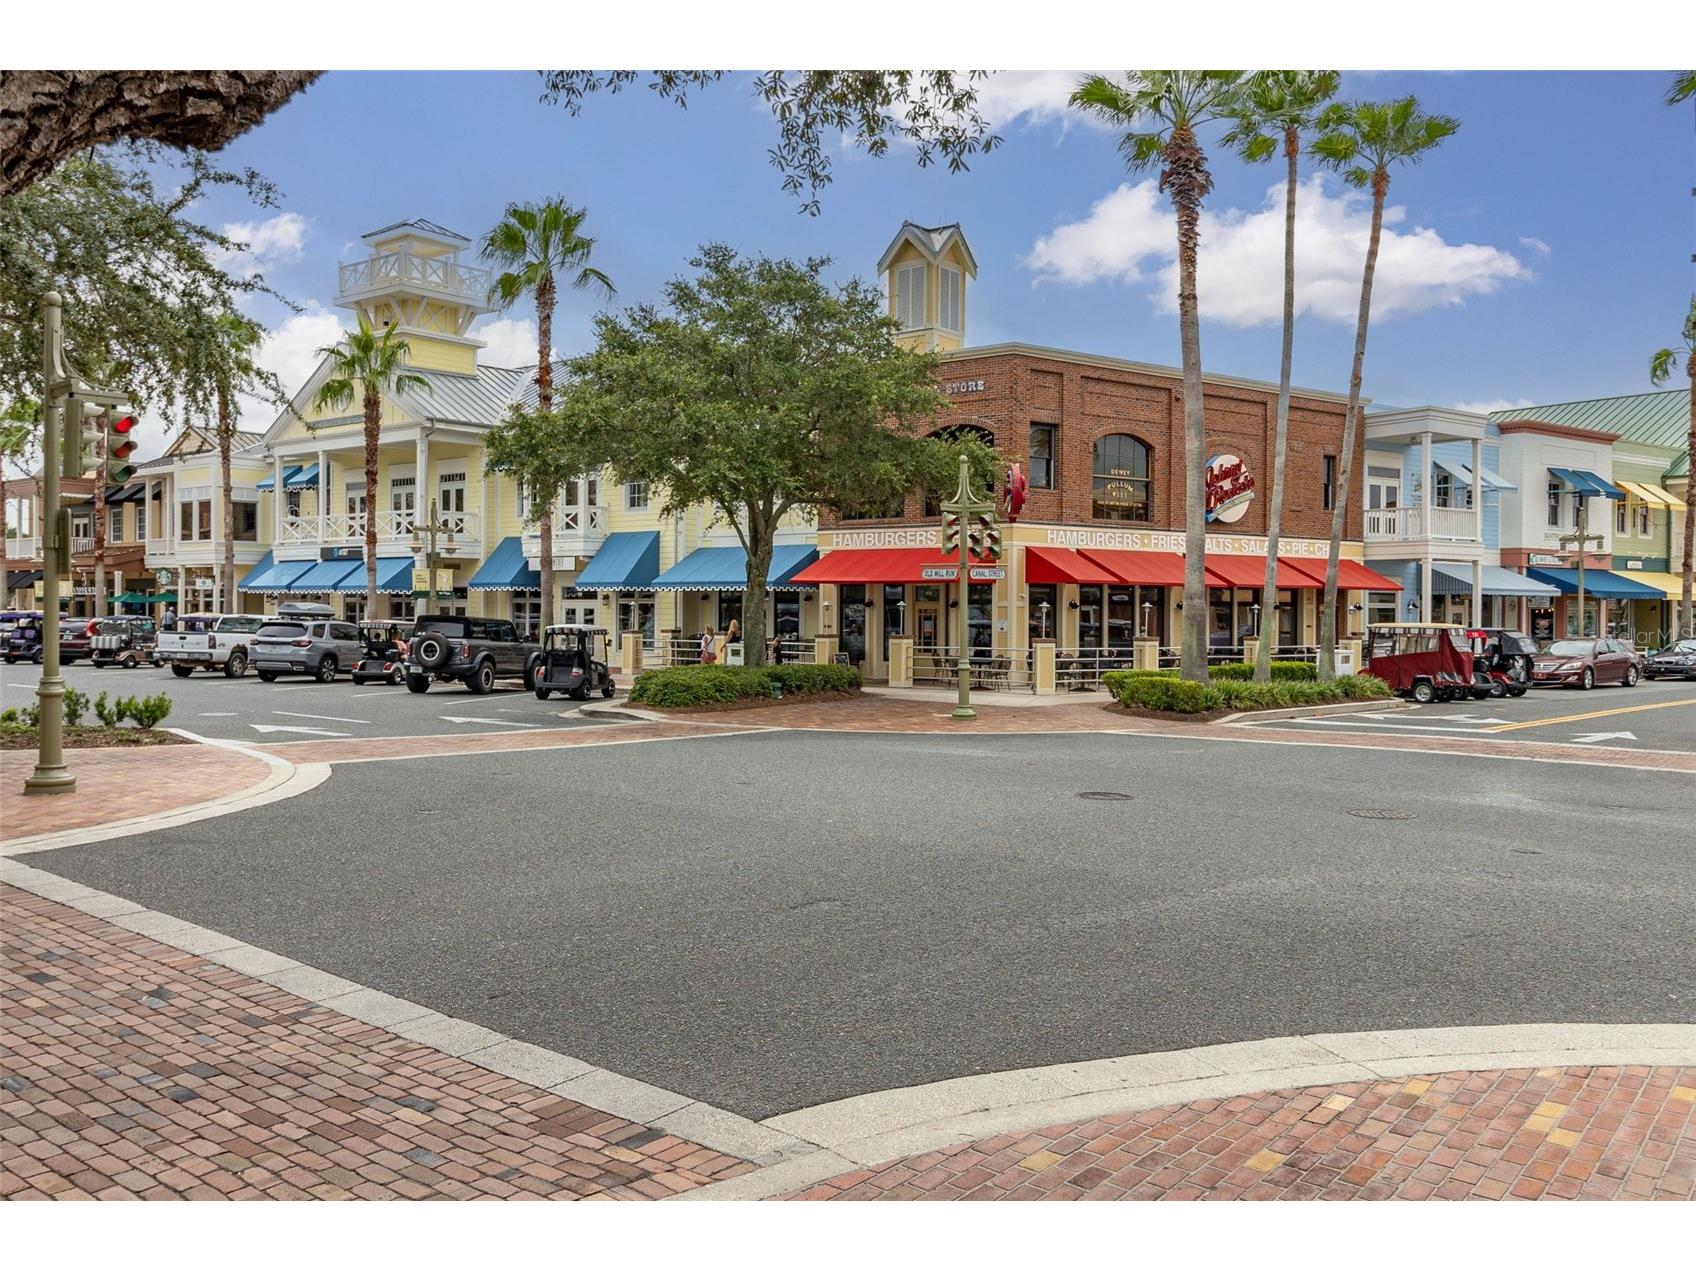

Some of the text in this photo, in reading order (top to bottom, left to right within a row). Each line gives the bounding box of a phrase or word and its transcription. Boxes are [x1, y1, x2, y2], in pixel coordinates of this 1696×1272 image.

[946, 380, 985, 394] STORE
[1106, 480, 1134, 493] PULLUM
[832, 530, 937, 547] HAMBURGERS
[1047, 529, 1141, 548] HAMBURGERS
[1151, 535, 1186, 550] FRIES
[1205, 538, 1232, 552] ALTS
[1241, 539, 1286, 554] SALAS
[1292, 542, 1308, 555] PIE
[971, 569, 1003, 577] CANAL STREET
